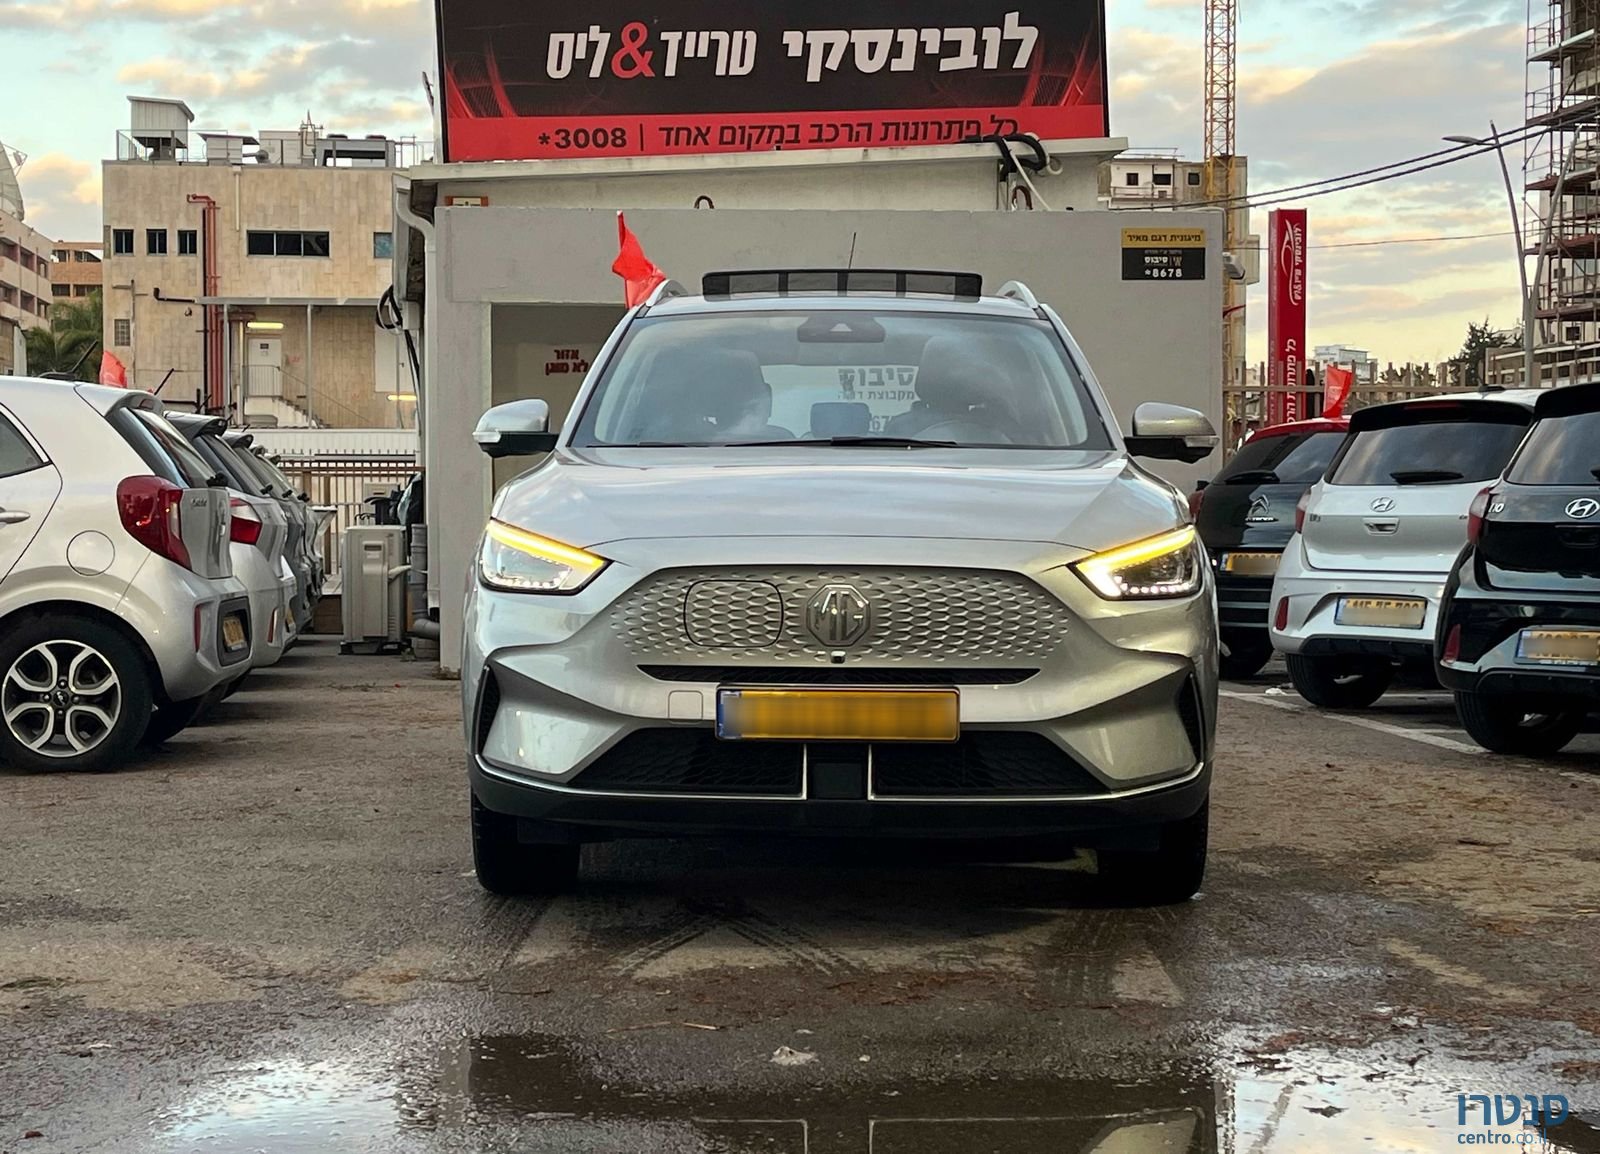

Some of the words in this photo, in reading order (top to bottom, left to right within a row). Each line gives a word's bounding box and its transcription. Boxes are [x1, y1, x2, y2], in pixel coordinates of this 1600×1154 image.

[783, 11, 1039, 82] לובינסקי
[808, 123, 872, 144] הרכב
[880, 120, 981, 142] פתרונות
[989, 114, 1018, 136] כל
[659, 126, 710, 147] אחד
[718, 124, 800, 150] במקום
[1127, 234, 1148, 242] מאיר
[1150, 234, 1167, 242] דגם
[1144, 256, 1168, 264] סיבוס
[1285, 338, 1296, 352] כל
[572, 359, 589, 373] לא
[1286, 354, 1296, 400] פתרונת
[867, 391, 915, 401] מקבוצת
[814, 590, 864, 641] MG
